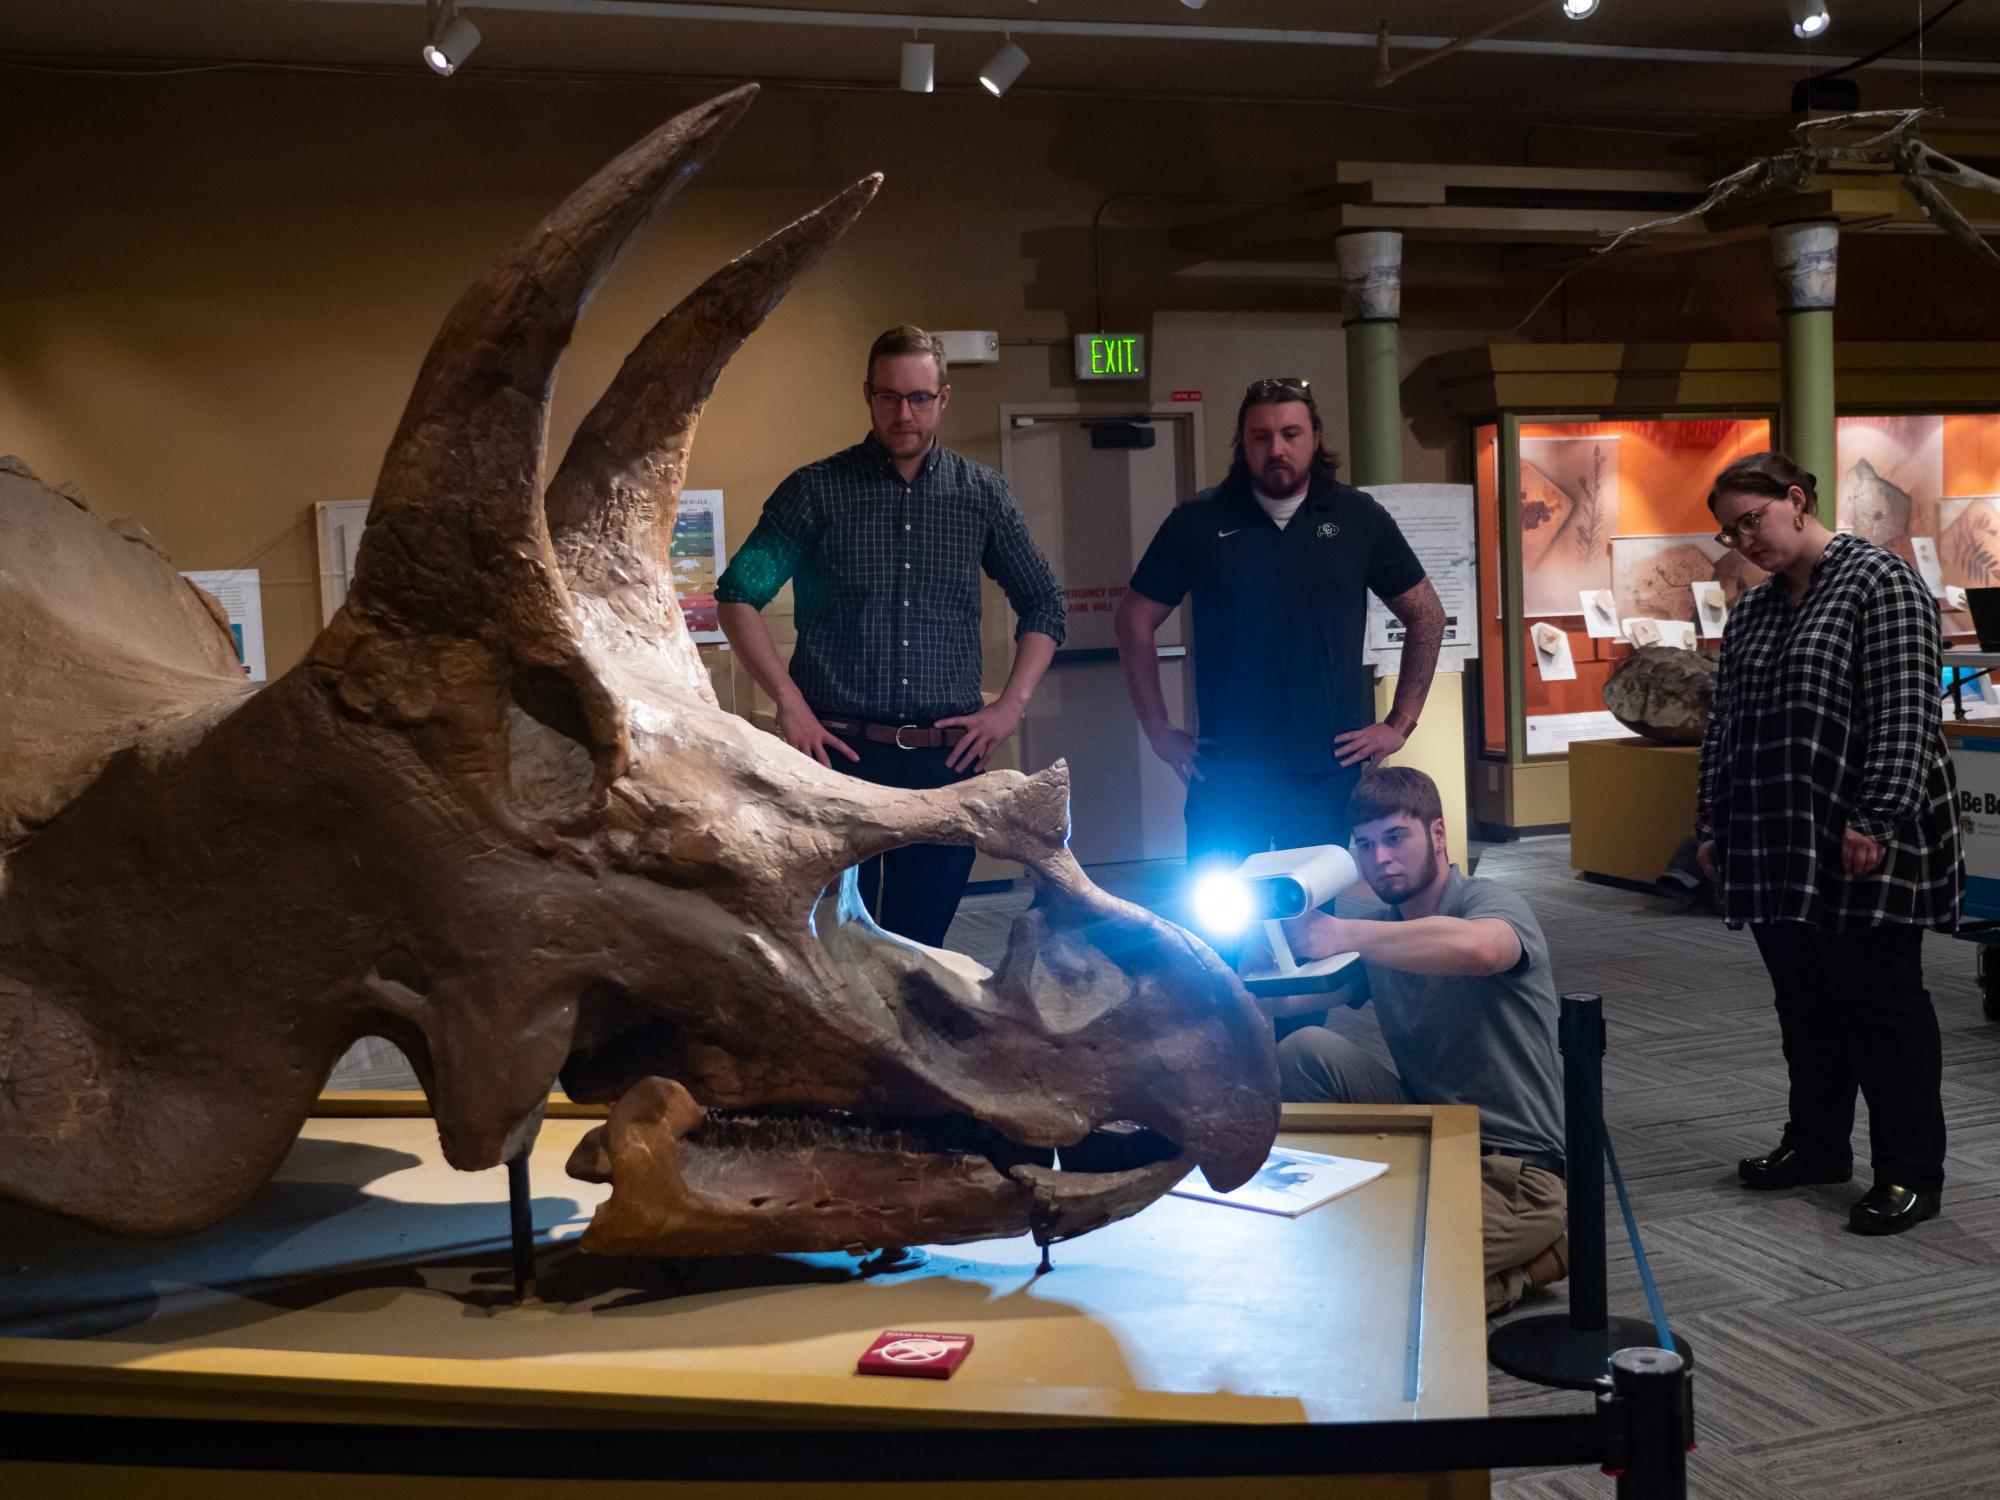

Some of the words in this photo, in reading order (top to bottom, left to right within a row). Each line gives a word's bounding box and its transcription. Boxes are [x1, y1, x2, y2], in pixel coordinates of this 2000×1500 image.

[1091, 339, 1136, 374] EXIT
[1065, 588, 1105, 599] ERGENCY
[1067, 603, 1089, 613] ARM
[1960, 790, 1983, 814] Be
